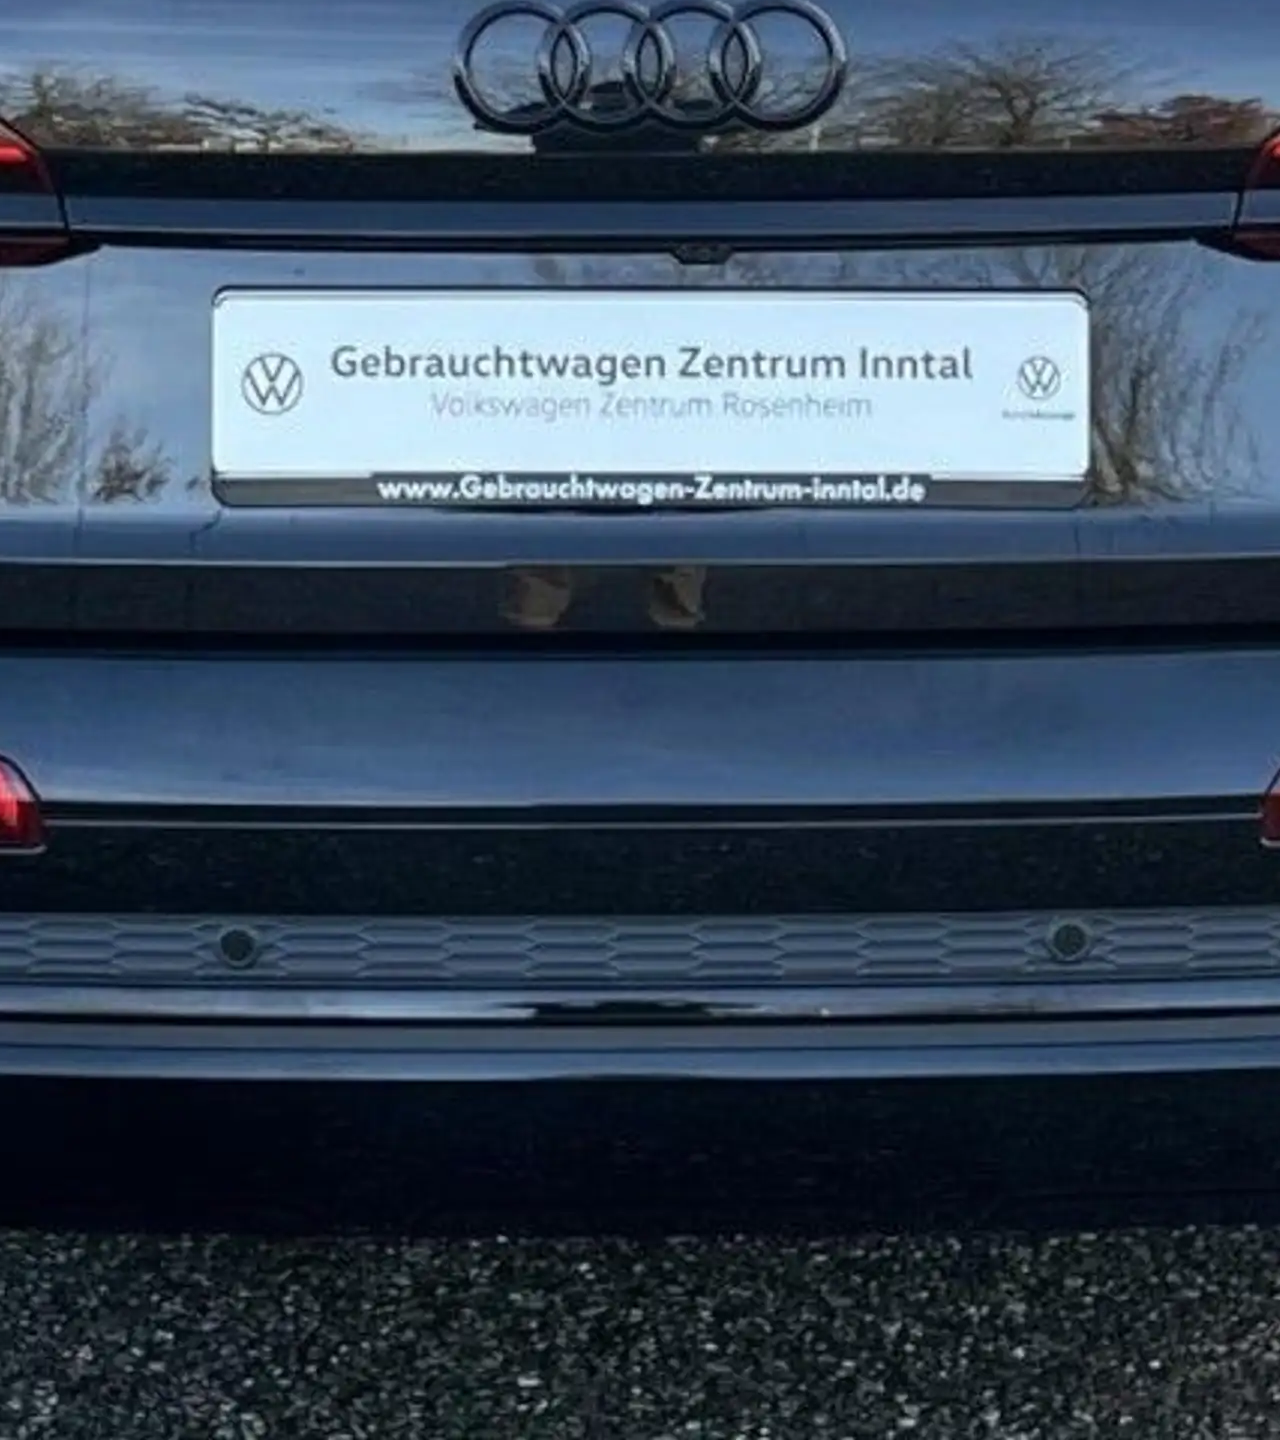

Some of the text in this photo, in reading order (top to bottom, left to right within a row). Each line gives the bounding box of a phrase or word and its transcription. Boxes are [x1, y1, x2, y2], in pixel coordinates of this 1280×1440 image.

[241, 352, 304, 416] VW
[330, 345, 973, 386] Gebrauchtwagen Zentrum Inntal
[432, 392, 873, 423] Volkswagen Zentrum Rosenheim
